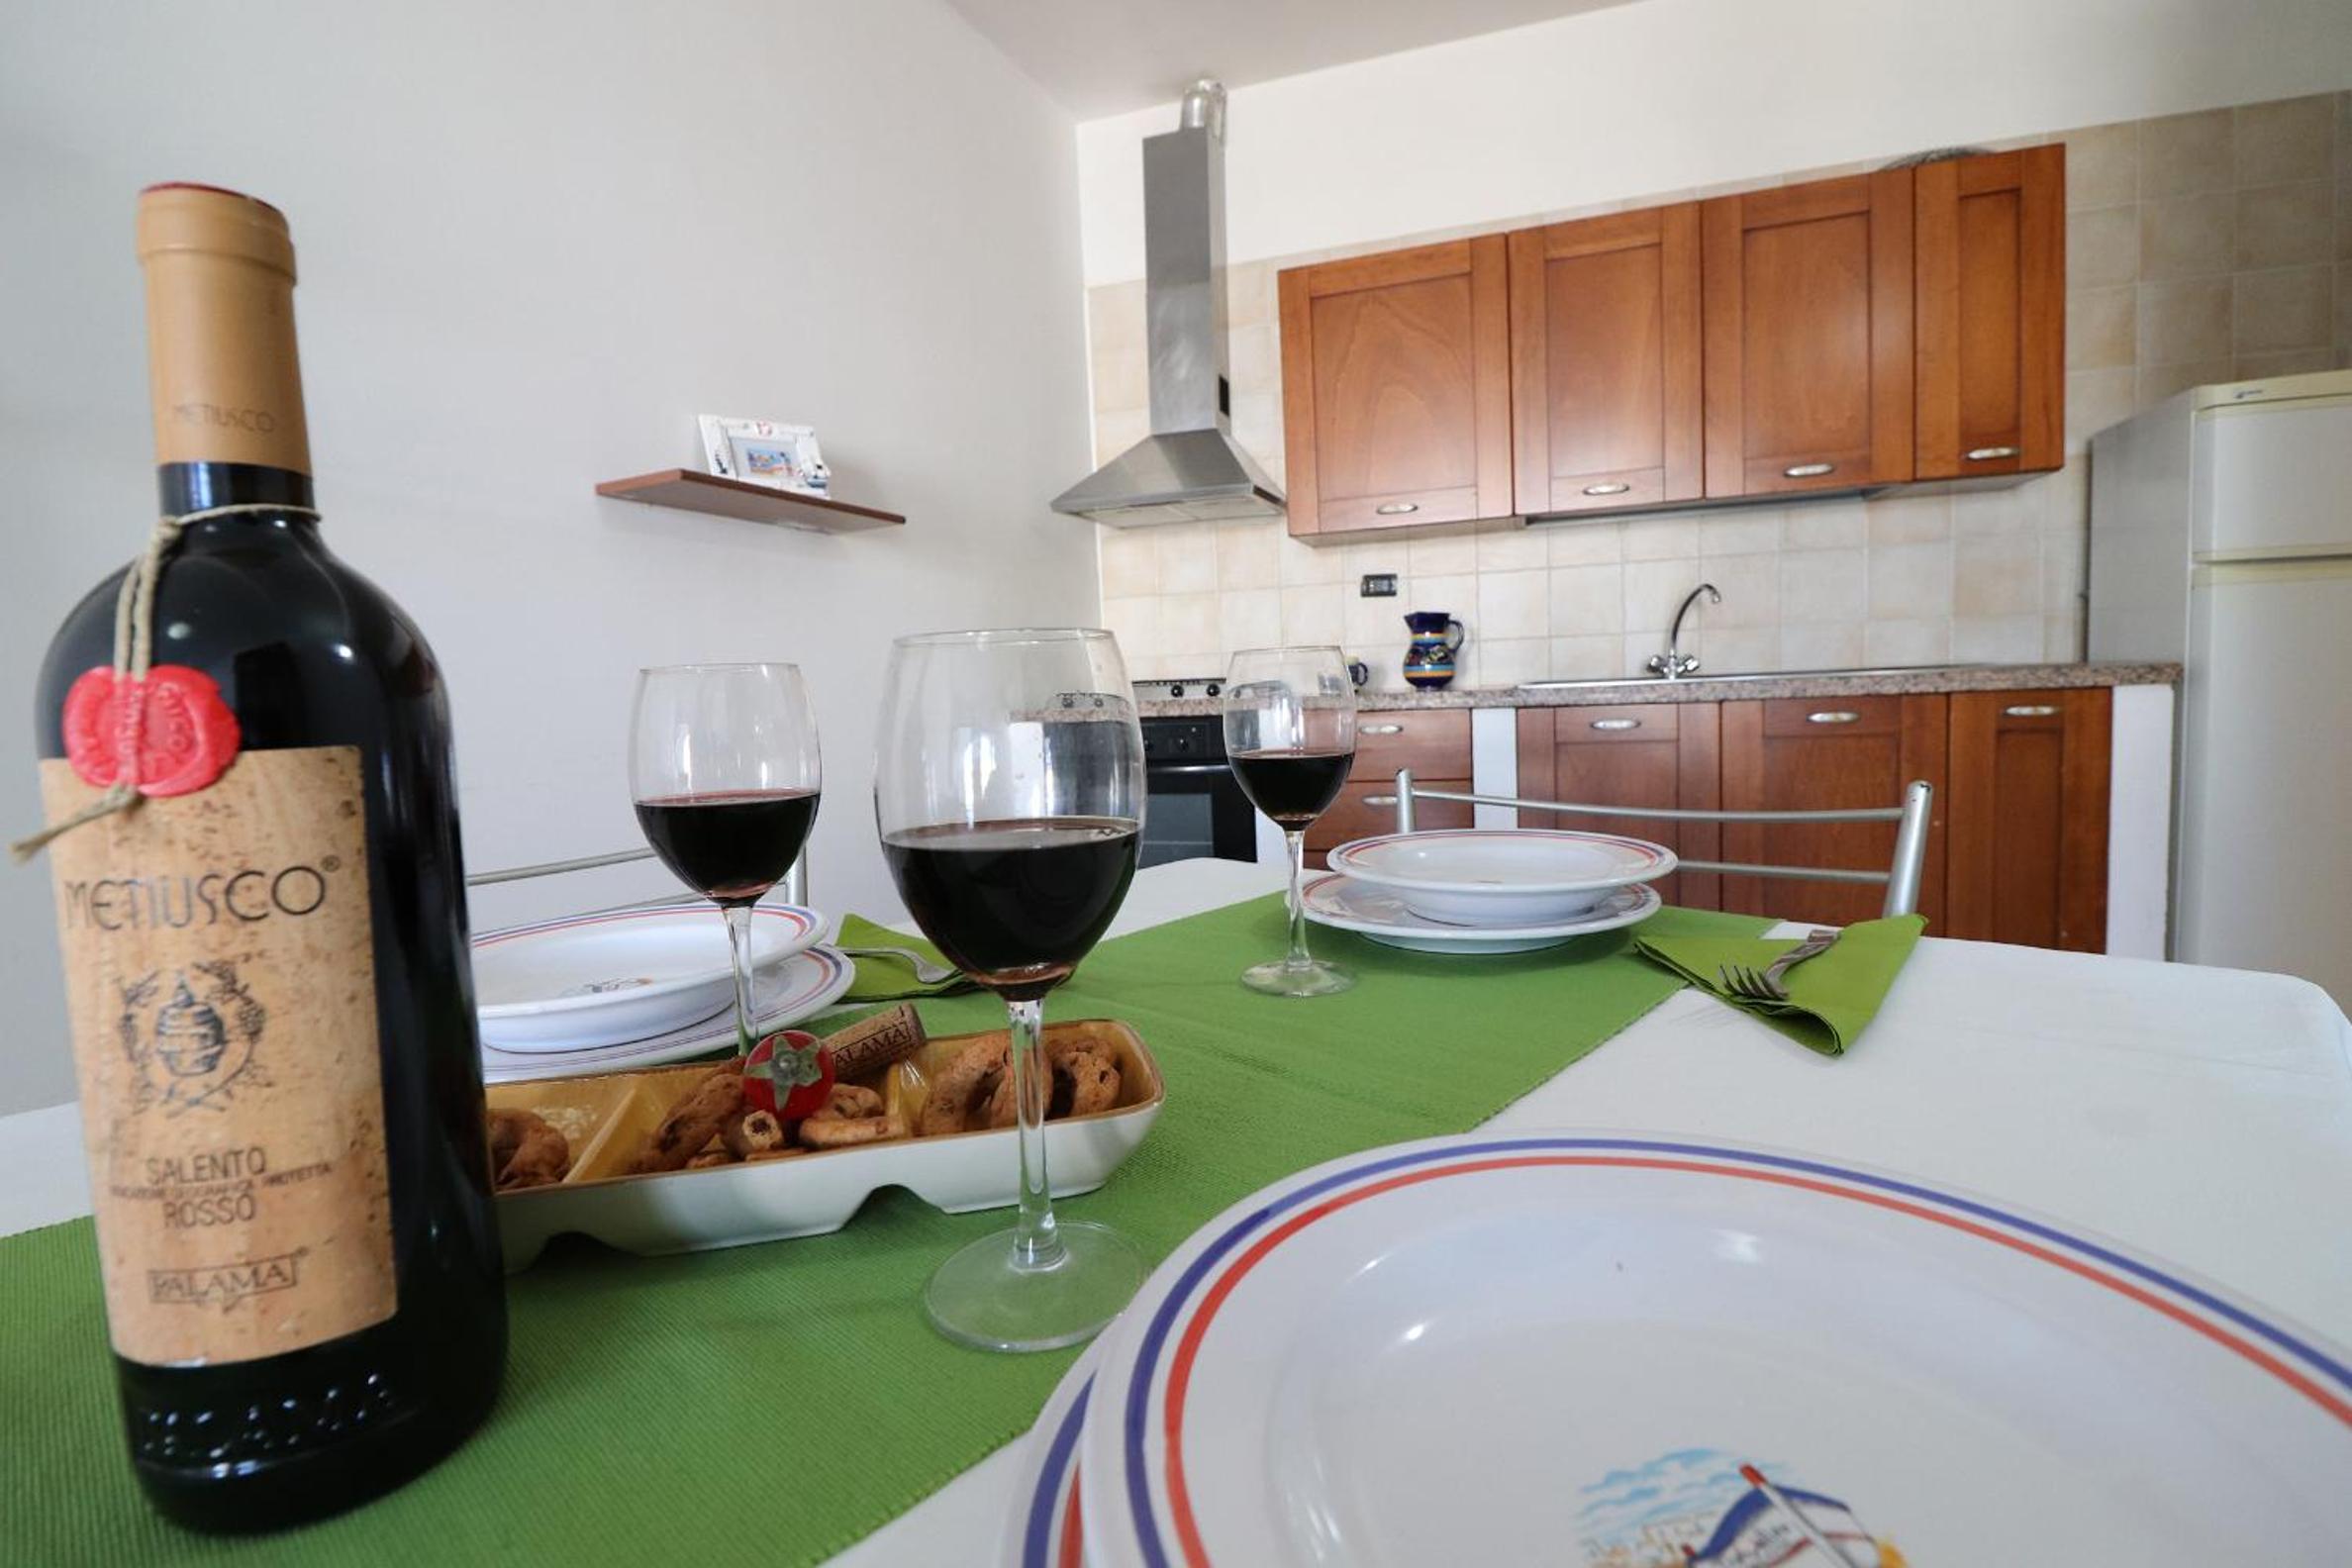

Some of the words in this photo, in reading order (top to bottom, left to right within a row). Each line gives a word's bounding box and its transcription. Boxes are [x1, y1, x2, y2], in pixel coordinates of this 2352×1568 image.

[833, 1027, 909, 1069] ALAMA
[146, 1145, 267, 1186] SALENTO
[162, 1193, 256, 1229] ROSSO
